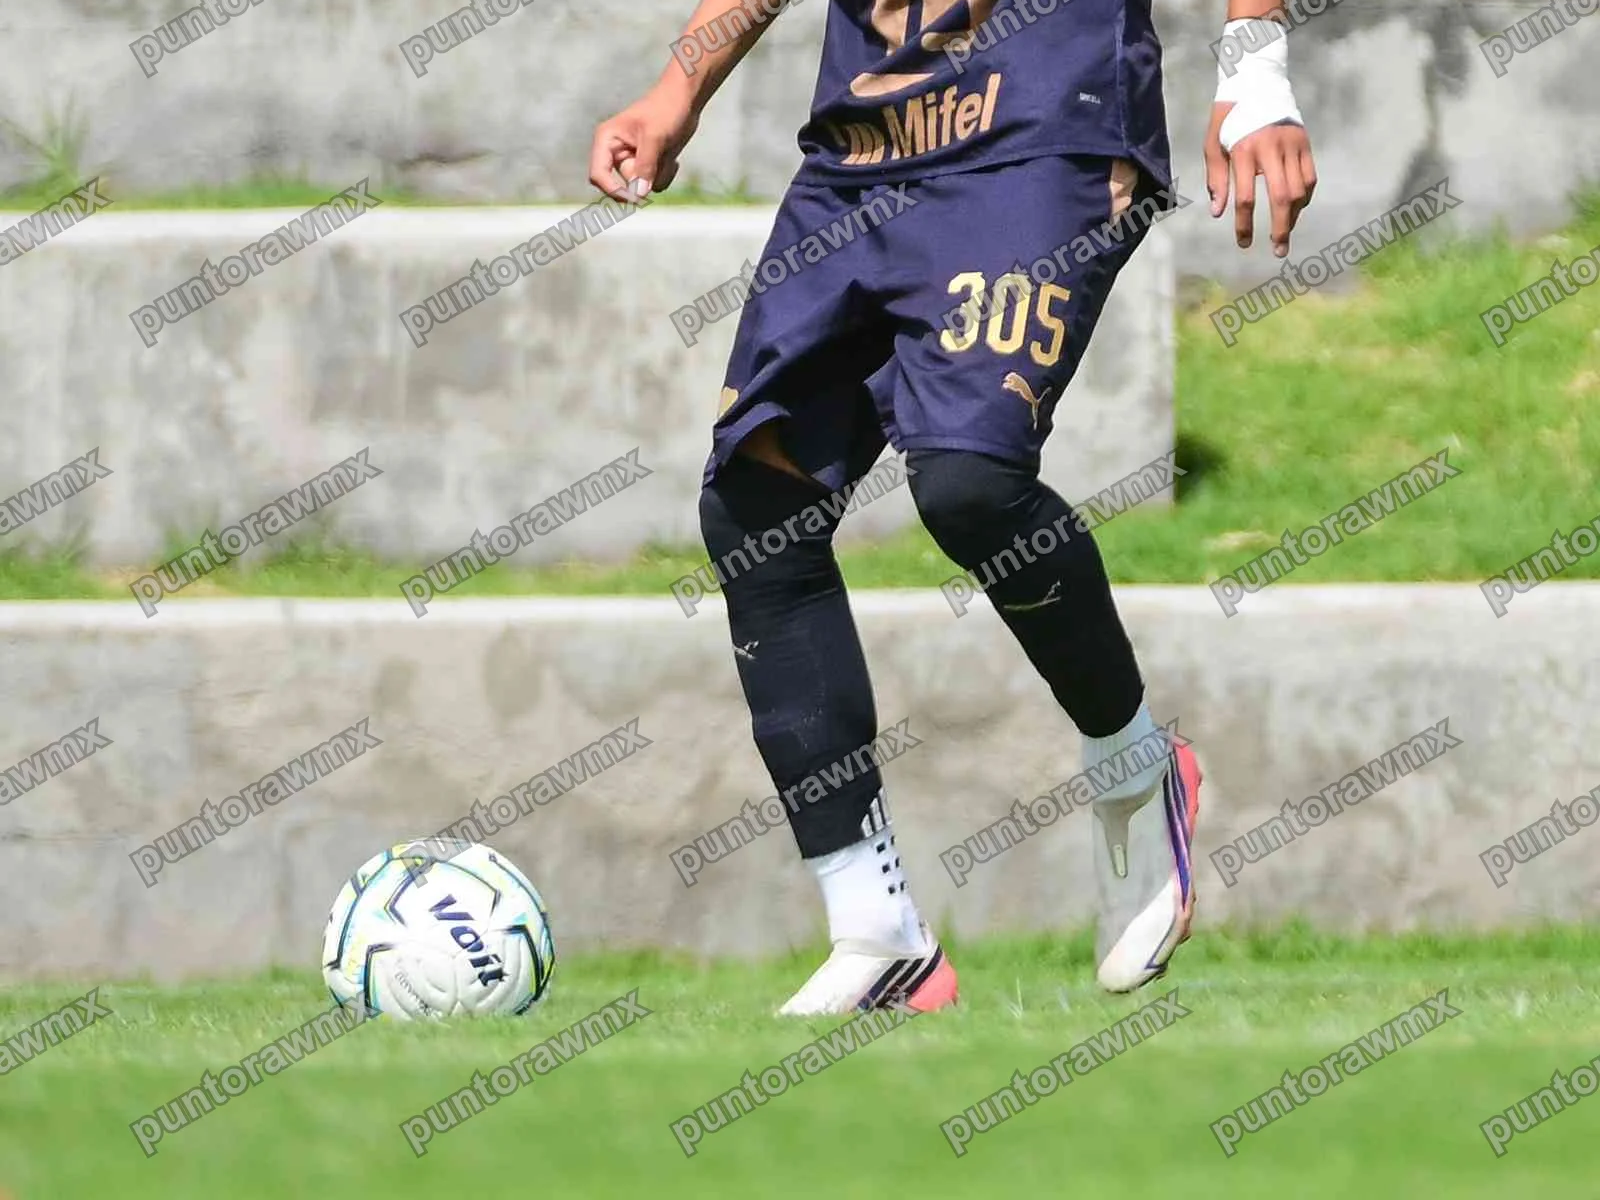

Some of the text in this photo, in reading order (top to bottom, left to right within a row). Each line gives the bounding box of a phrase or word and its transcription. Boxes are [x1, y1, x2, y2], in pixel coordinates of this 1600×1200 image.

[881, 73, 1001, 160] Mifel
[940, 271, 1071, 367] 305
[428, 893, 509, 987] Voit
